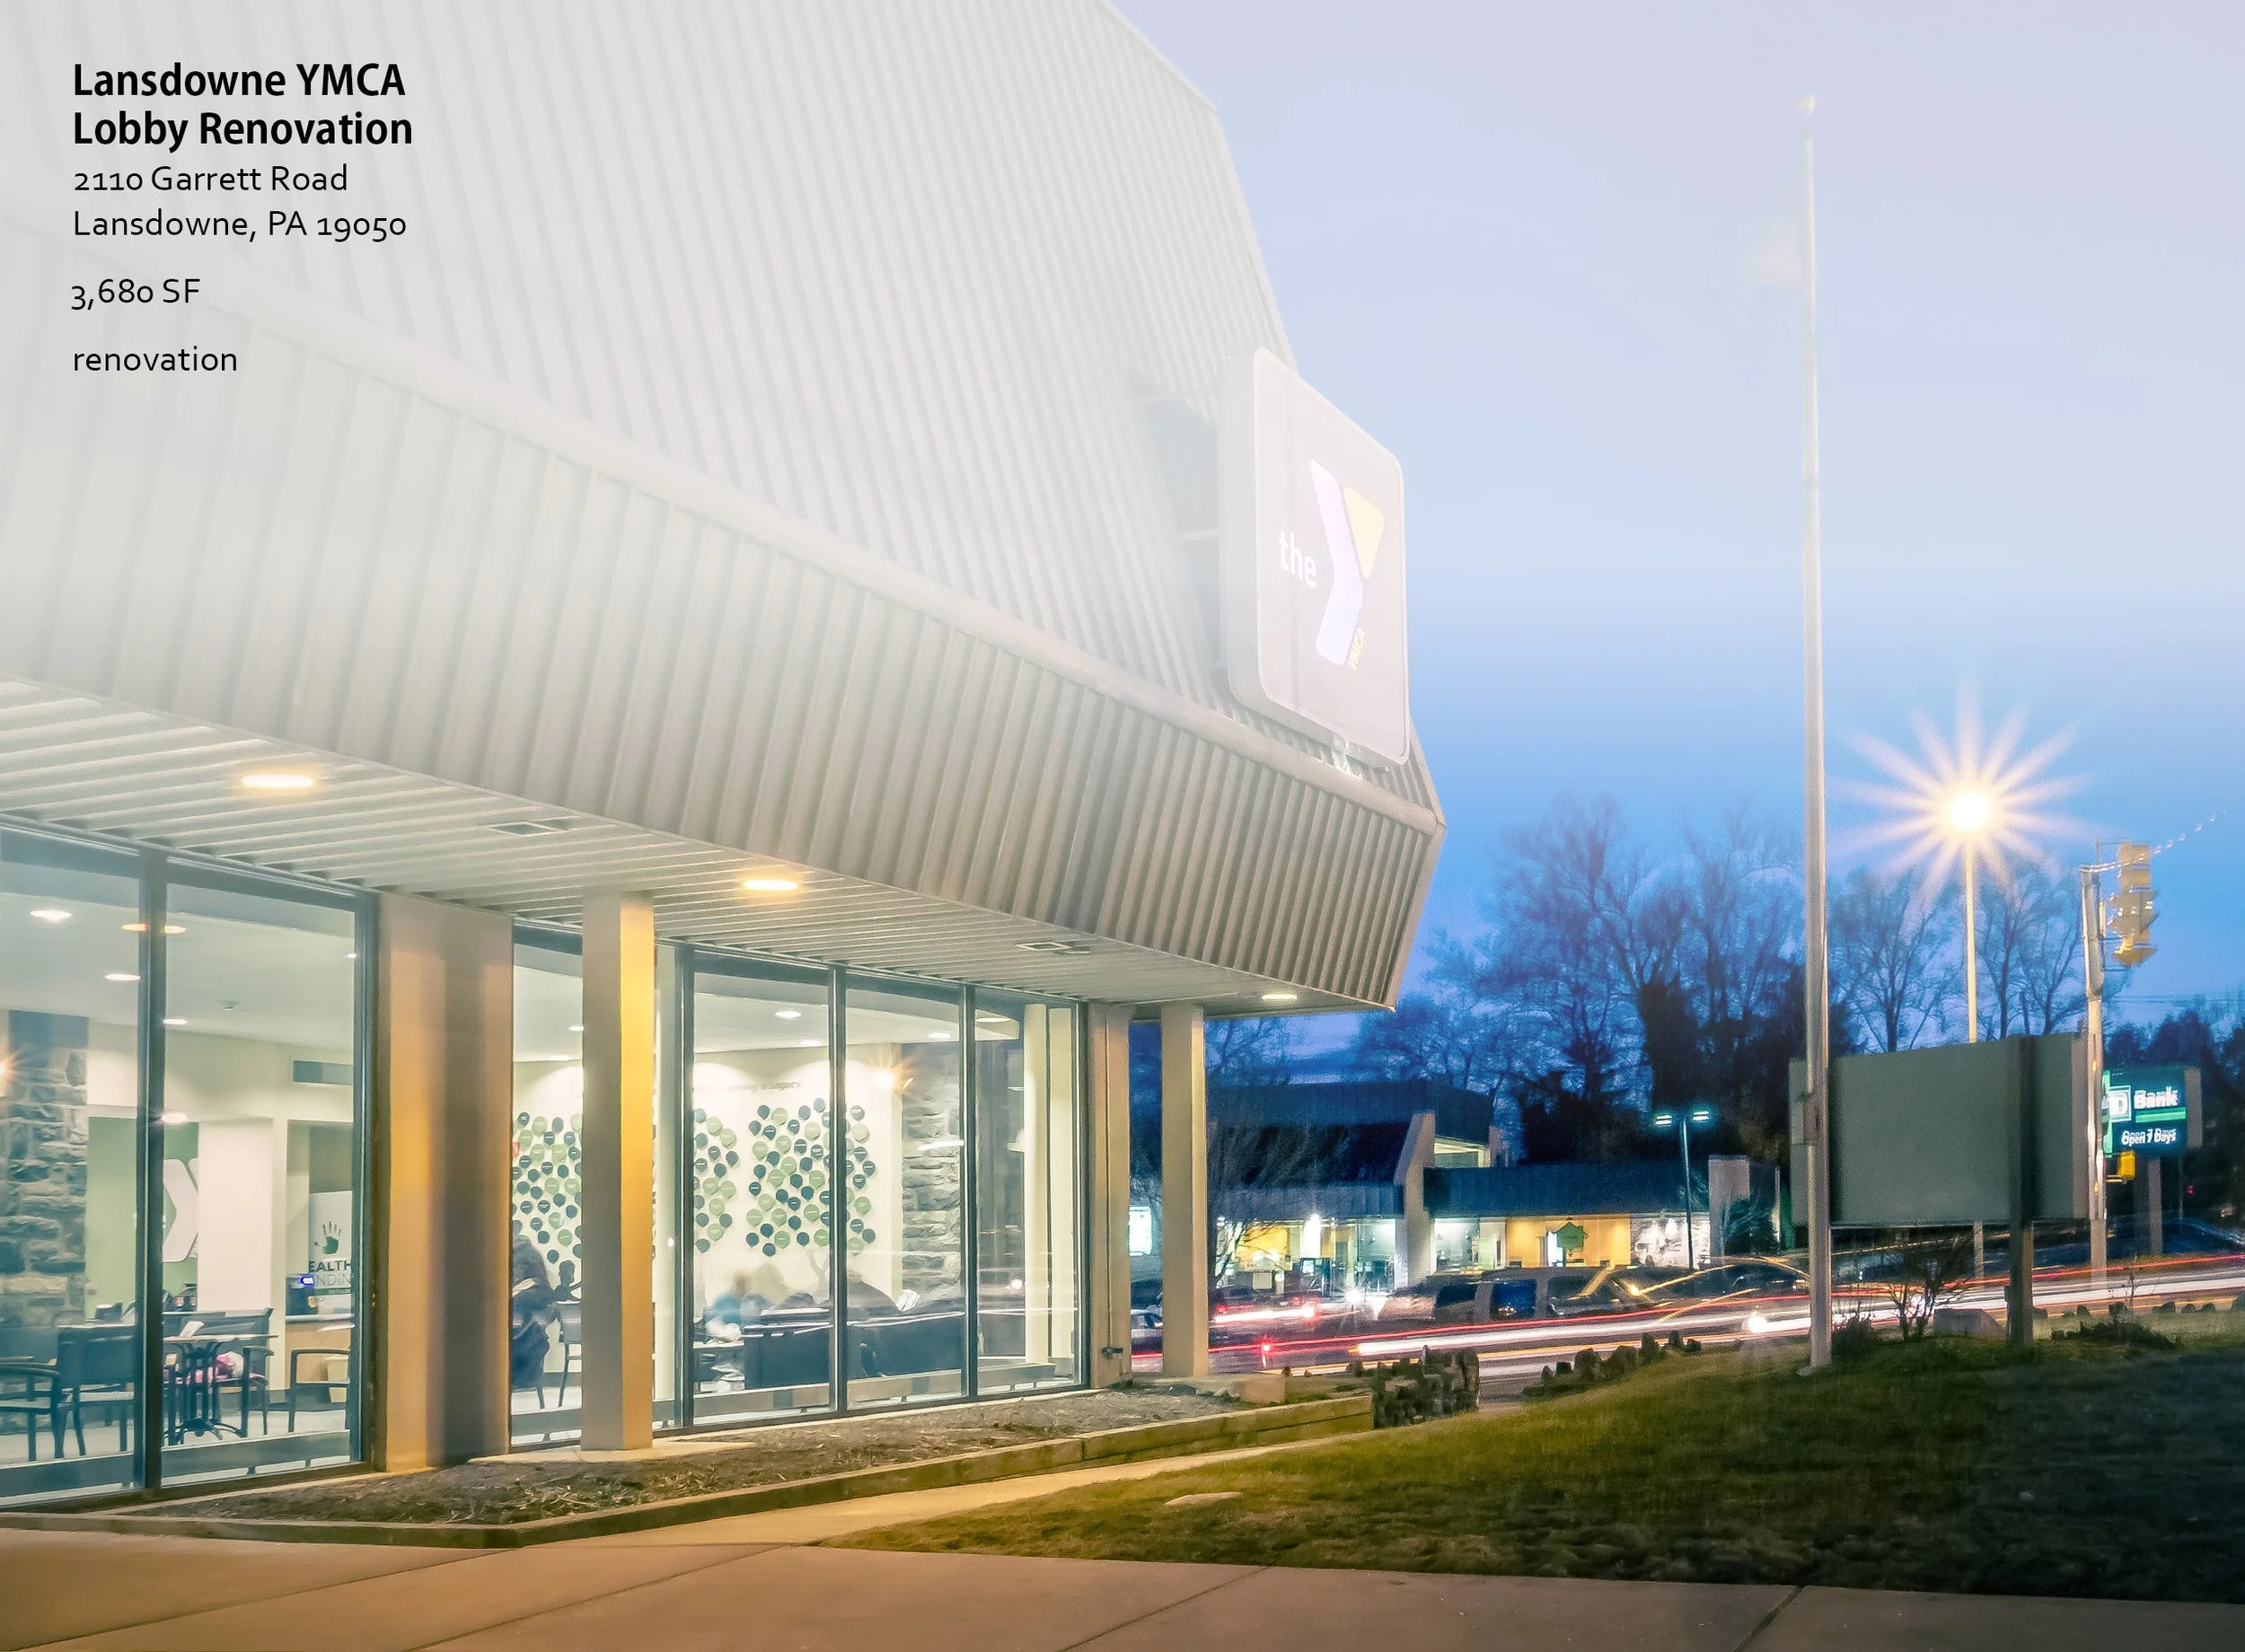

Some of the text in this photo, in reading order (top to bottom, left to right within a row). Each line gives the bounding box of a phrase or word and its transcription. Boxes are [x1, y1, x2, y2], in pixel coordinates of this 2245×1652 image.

[1278, 530, 1318, 589] the
[2134, 1086, 2178, 1109] Bank
[2122, 1129, 2177, 1147] Open 7 Days
